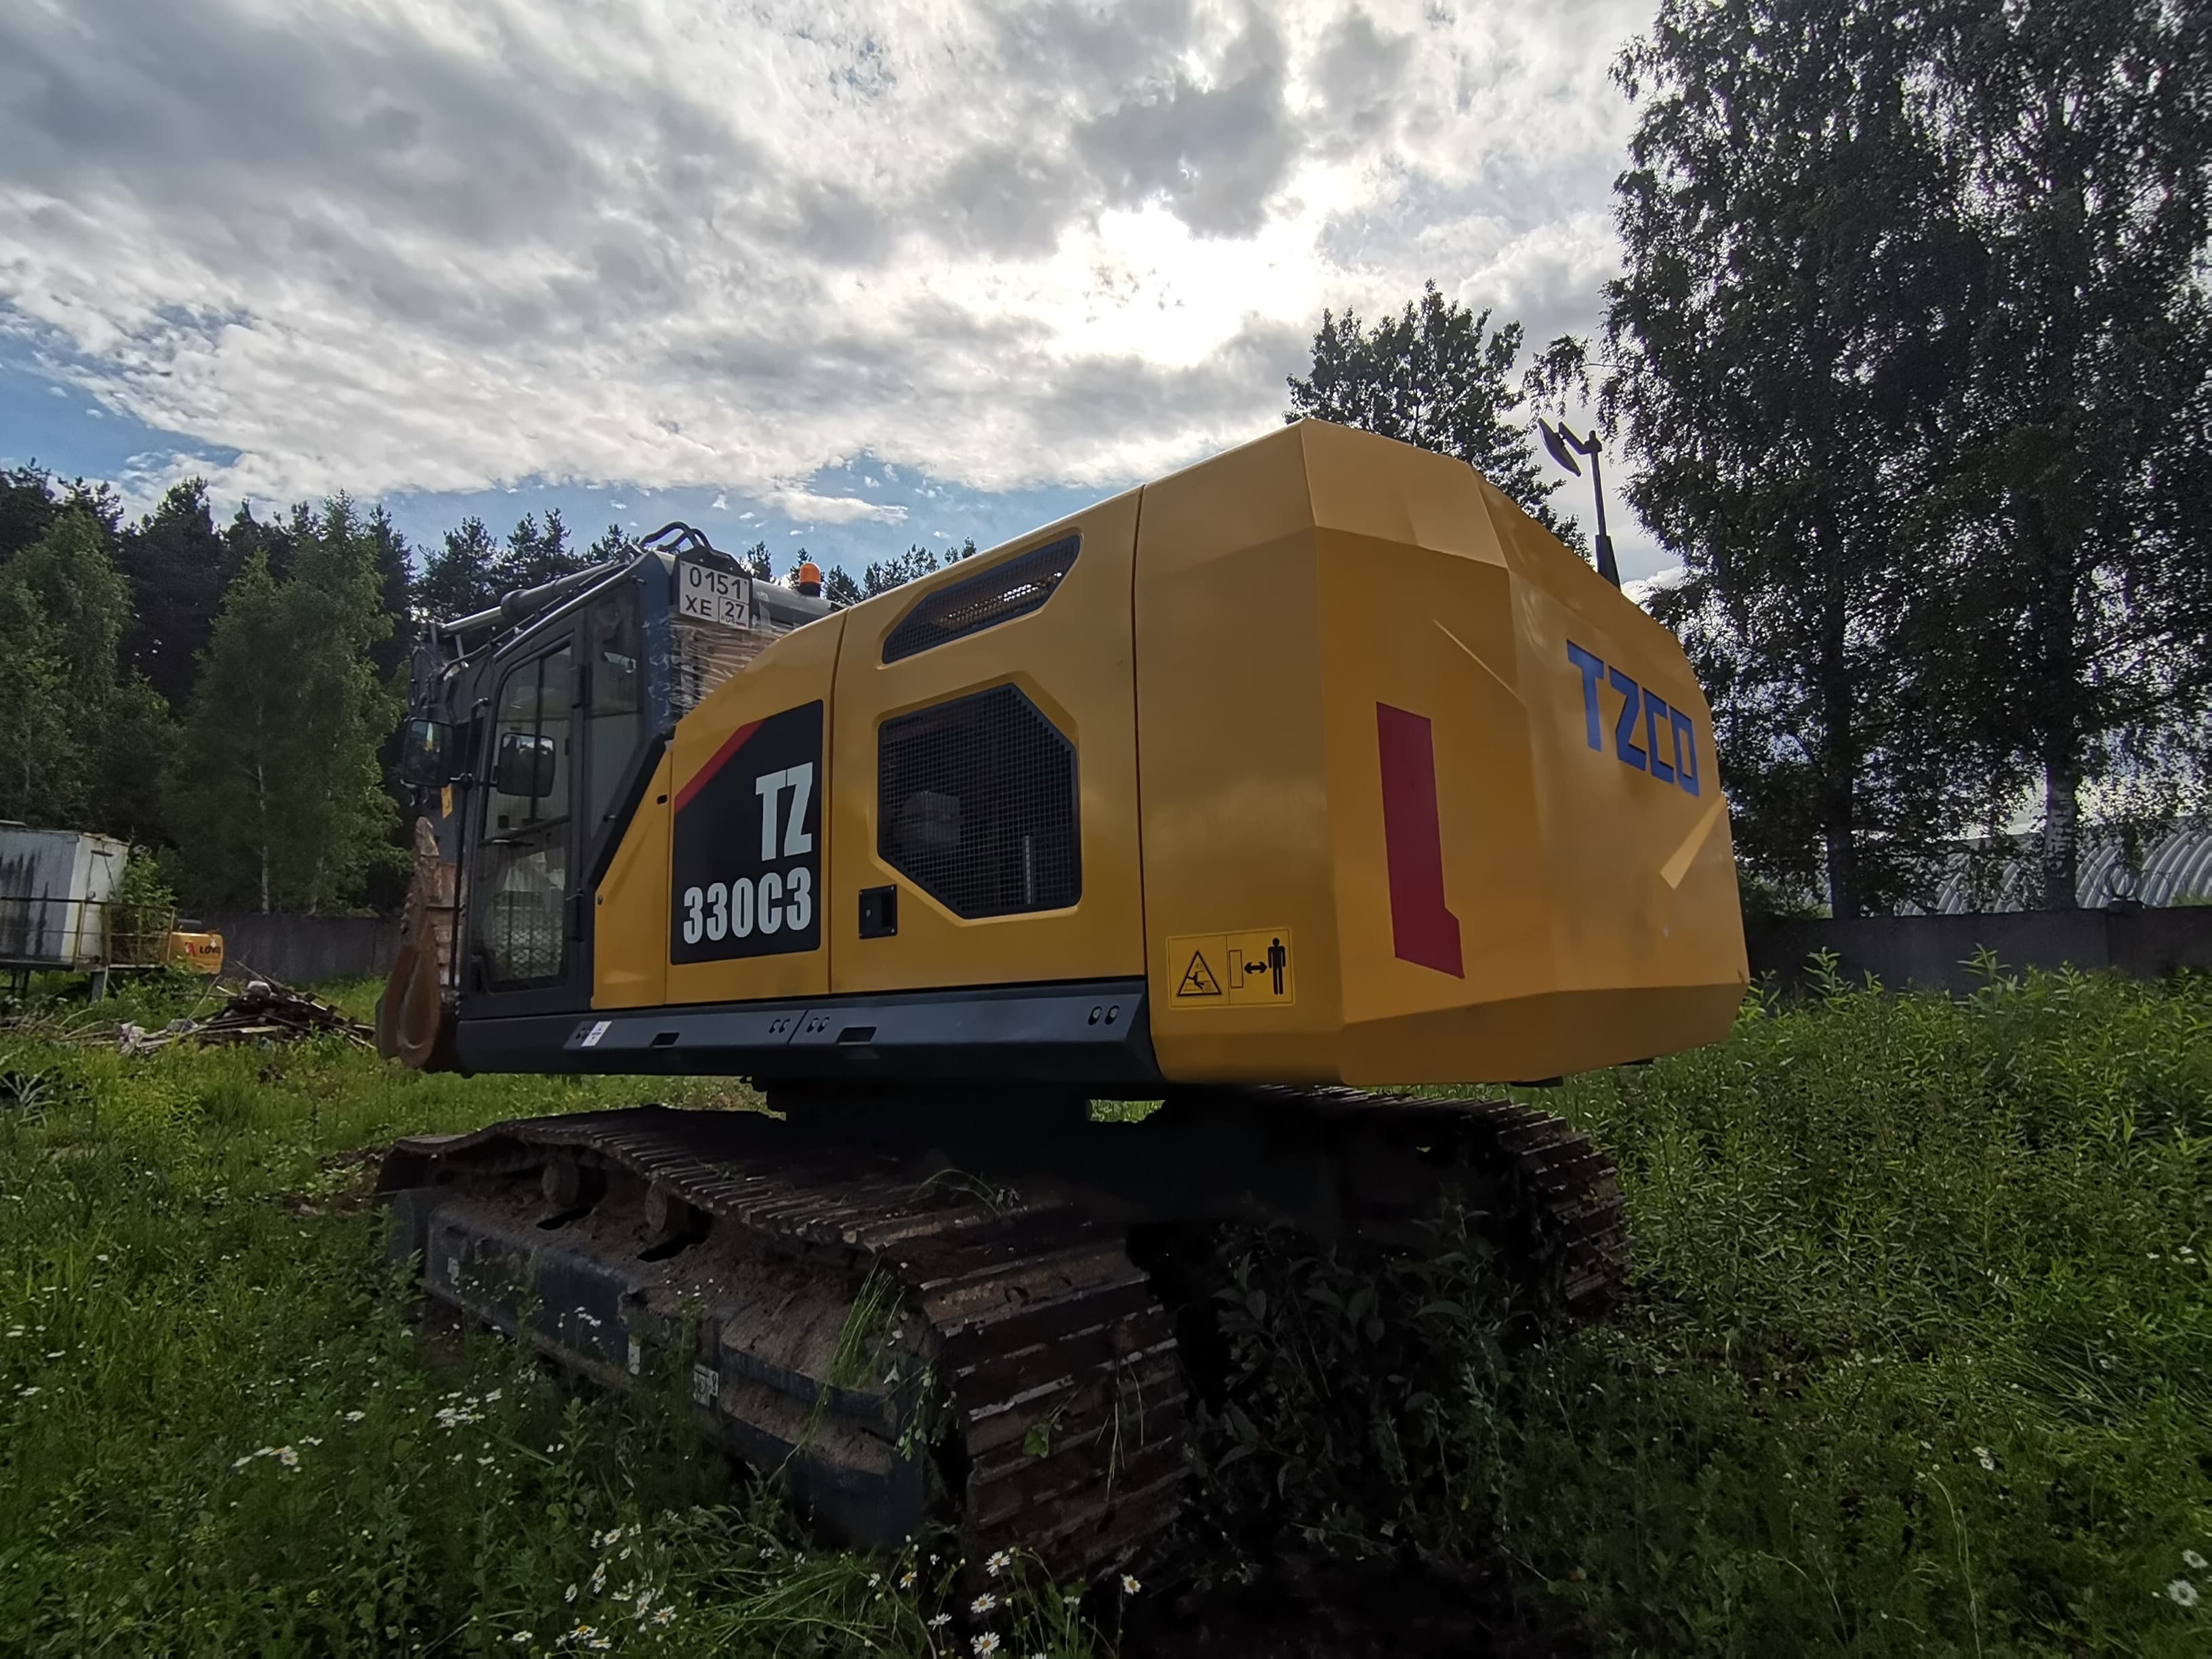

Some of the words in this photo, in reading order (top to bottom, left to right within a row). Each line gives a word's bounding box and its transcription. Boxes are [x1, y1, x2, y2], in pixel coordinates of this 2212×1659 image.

[685, 594, 712, 617] XE
[725, 601, 745, 619] 27
[689, 566, 741, 600] 0151
[1566, 638, 1700, 798] TZCO
[755, 761, 813, 862] TZ
[683, 867, 812, 944] 330C3
